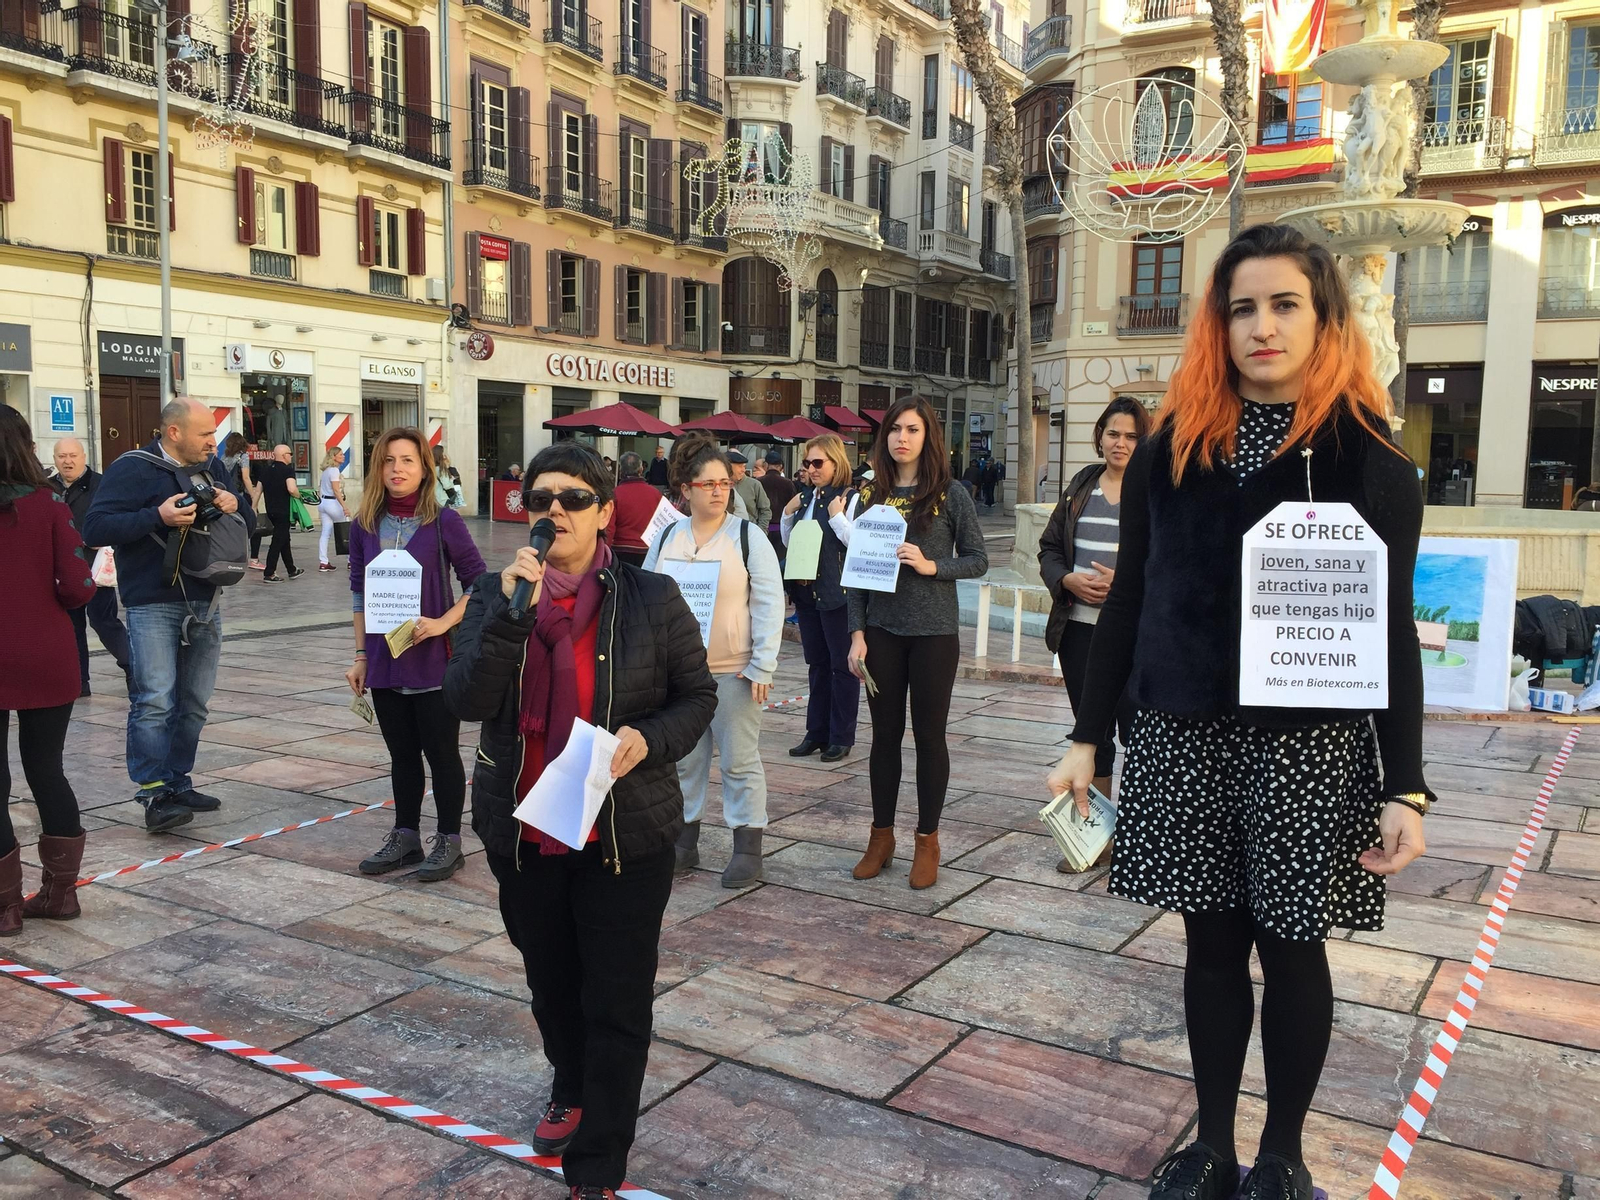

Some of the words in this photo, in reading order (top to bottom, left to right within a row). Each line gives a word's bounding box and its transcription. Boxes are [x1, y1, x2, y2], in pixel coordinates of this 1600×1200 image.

[470, 332, 486, 342] COSTA
[101, 341, 162, 357] LODGIN
[469, 347, 487, 360] COFFEE
[122, 355, 155, 364] MALAGA
[369, 363, 380, 374] EL
[383, 364, 416, 377] GANSO
[547, 353, 611, 381] COSTA
[613, 361, 675, 388] COFFEE
[734, 390, 757, 401] UNO
[766, 390, 782, 402] 50
[53, 399, 71, 413] AT
[599, 427, 617, 435] COSTA
[253, 451, 275, 460] REBAJAS
[859, 521, 872, 530] PVP
[1265, 522, 1286, 539] SE
[1291, 523, 1365, 541] OFRECE
[869, 532, 896, 540] DONANTE
[866, 560, 896, 569] RESULTADOS
[1260, 553, 1310, 571] joven,
[1314, 558, 1351, 570] sana
[1356, 560, 1366, 572] y
[371, 569, 386, 577] PVP
[387, 570, 417, 578] 35.000€
[682, 582, 711, 590] 100.000€
[1257, 579, 1327, 593] atractiva
[1332, 582, 1369, 596] para
[397, 593, 420, 601] (griega)
[693, 600, 712, 608] ÚTERO
[696, 610, 711, 618] USA)
[1251, 604, 1281, 619] que
[1285, 603, 1339, 620] tengas
[1344, 603, 1375, 621] hijo
[1276, 626, 1335, 641] PRECIO
[1339, 628, 1352, 641] A
[1270, 651, 1357, 667] CONVENIR
[1265, 676, 1288, 687] Más
[1290, 679, 1303, 688] en
[1306, 678, 1380, 690] Biotexcom.es
